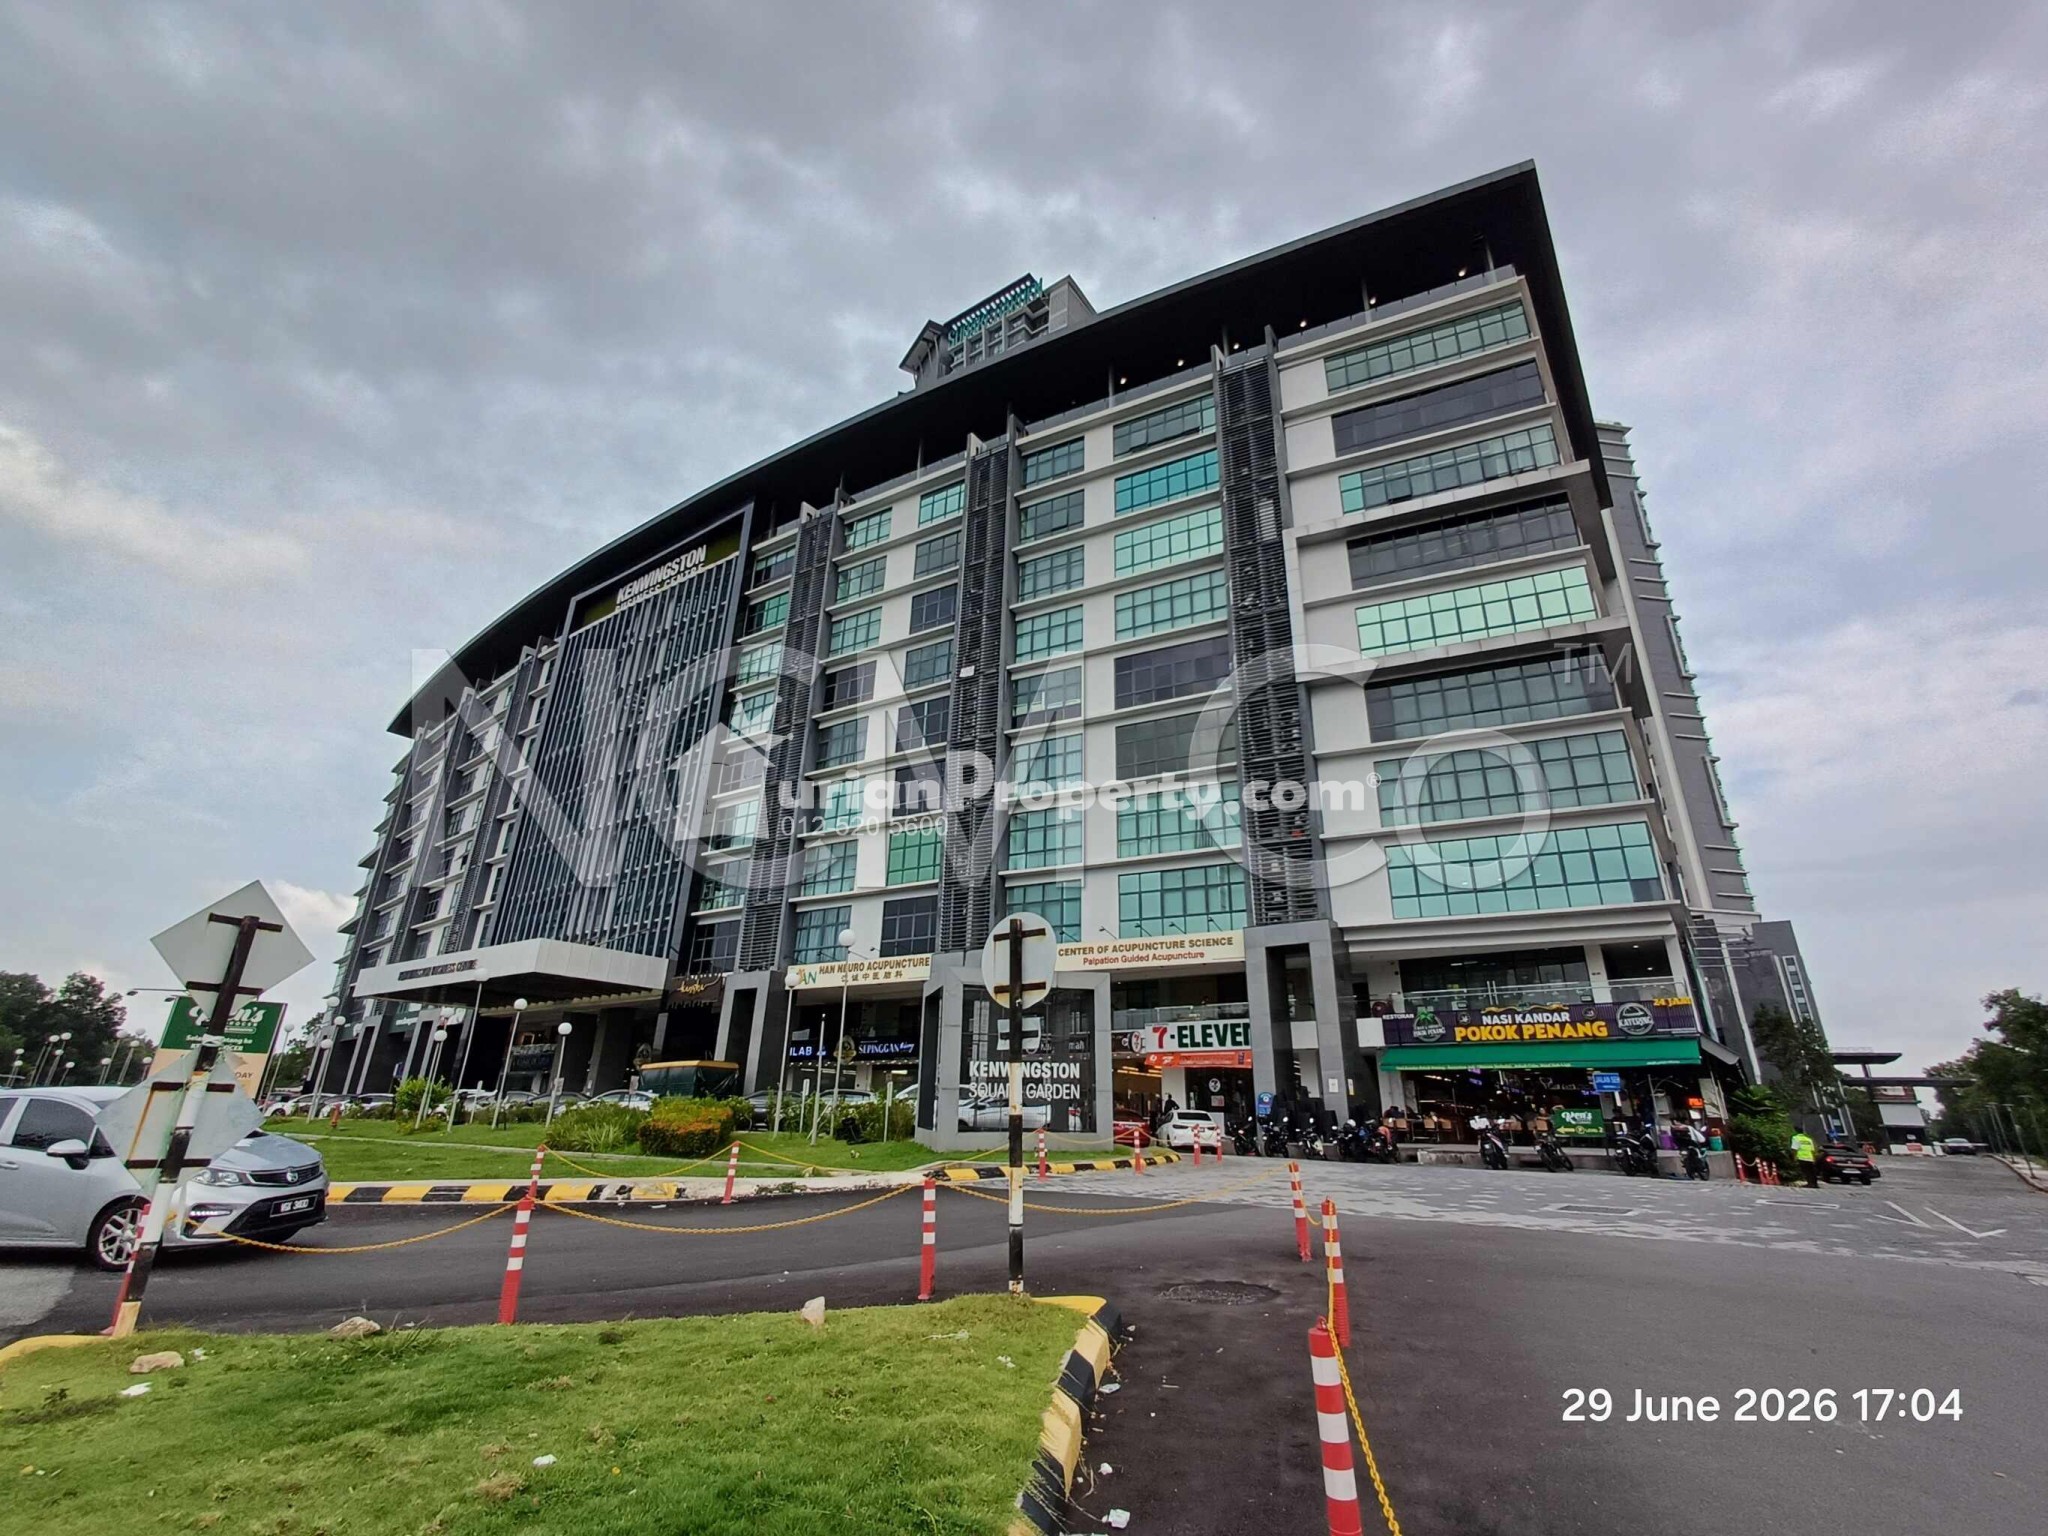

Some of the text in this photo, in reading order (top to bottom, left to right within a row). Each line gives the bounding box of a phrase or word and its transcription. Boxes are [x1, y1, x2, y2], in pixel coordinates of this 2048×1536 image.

[616, 544, 707, 605] KENWINGSTON
[1058, 936, 1234, 957] CENTER OF ACUPUNCTURE SCIENCE
[819, 956, 931, 975] HAN NEURO ACUPUNCTURE
[1083, 950, 1206, 966] Palpation Guided Acupuncture
[1482, 1011, 1571, 1025] NASI KANDAR
[1454, 1021, 1609, 1042] POKOK PENANG
[789, 1045, 813, 1057] ILAB
[969, 1060, 1080, 1079] KENWNGSTON
[969, 1082, 1081, 1100] SQUA GARDEN
